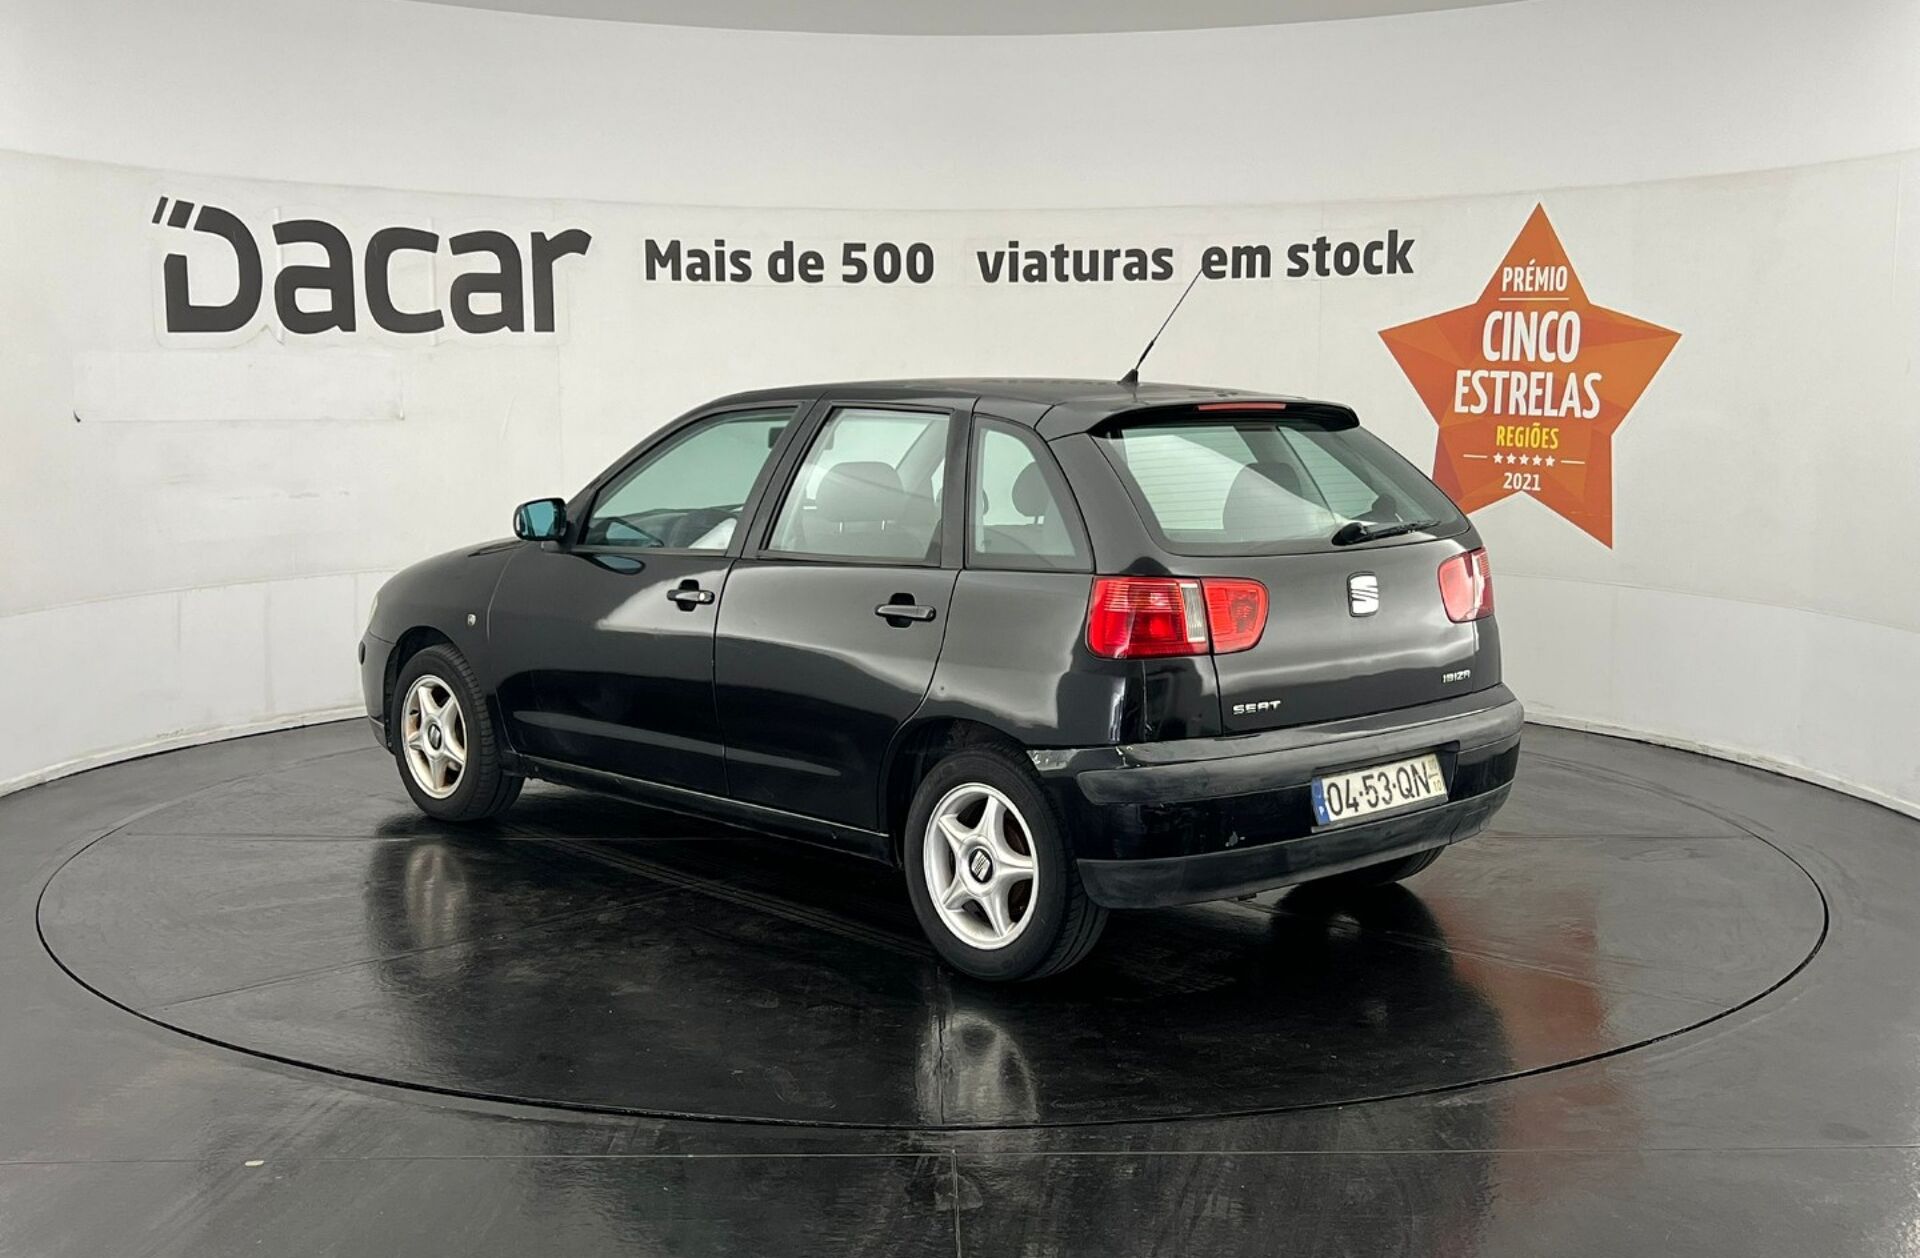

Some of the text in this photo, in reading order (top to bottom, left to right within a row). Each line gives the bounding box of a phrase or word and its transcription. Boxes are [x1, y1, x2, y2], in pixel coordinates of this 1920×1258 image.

[151, 196, 593, 335] Dacar
[645, 229, 1415, 284] Mais de 500 viaturas em stock
[1501, 258, 1569, 292] PRÉMIO
[1482, 310, 1581, 364] CINCO
[1454, 369, 1603, 420] ESTRELAS
[1495, 421, 1560, 450] REGIÕES
[1503, 471, 1541, 492] 2021
[1442, 669, 1471, 684] IBIZA
[1232, 700, 1281, 715] SEAT
